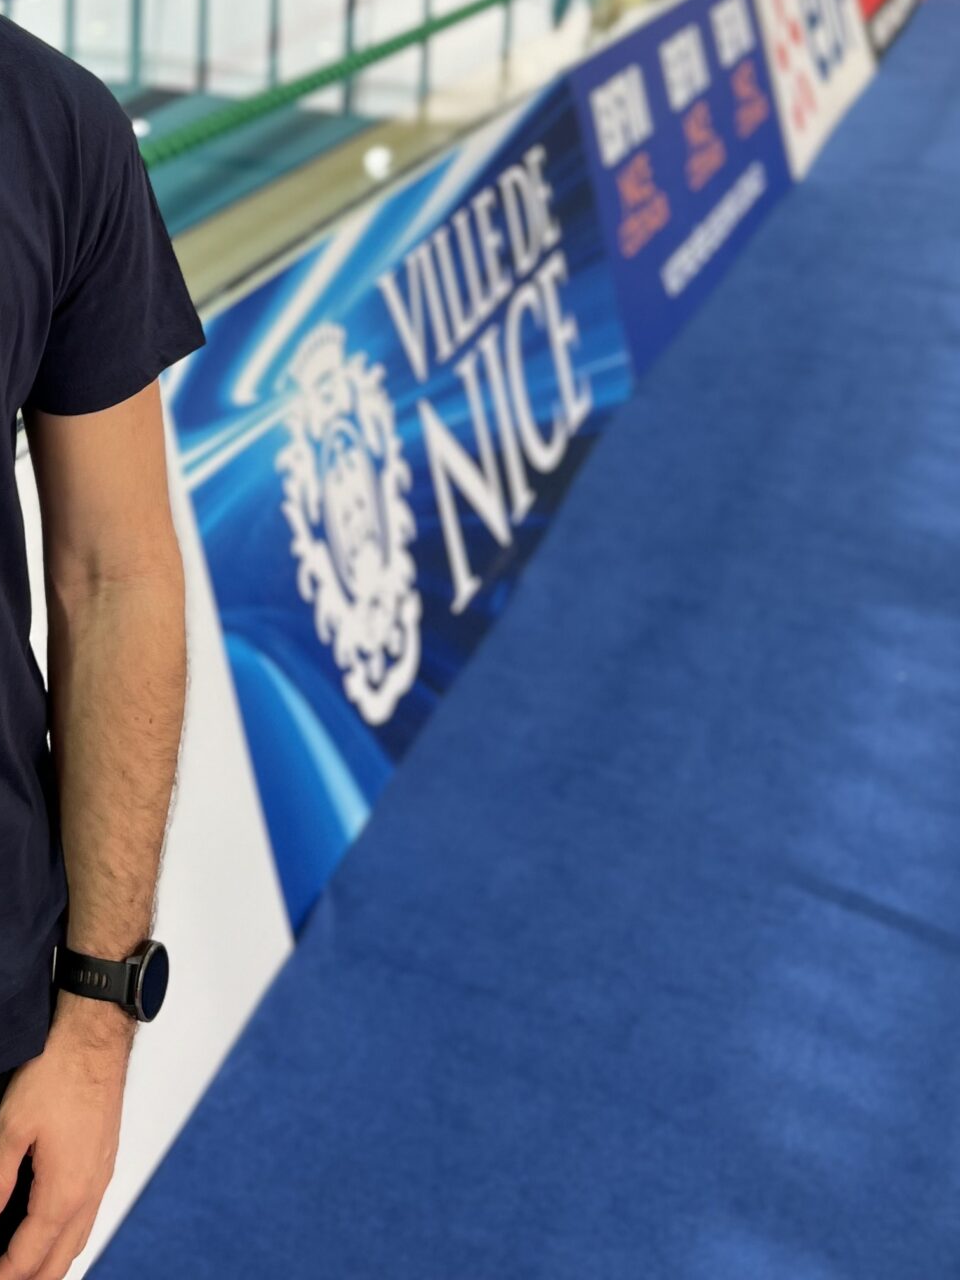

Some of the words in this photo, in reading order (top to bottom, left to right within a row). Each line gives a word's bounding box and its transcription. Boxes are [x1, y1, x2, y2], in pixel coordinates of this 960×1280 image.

[377, 187, 513, 382] VILLE
[498, 143, 561, 278] DE
[417, 249, 594, 614] NICE
